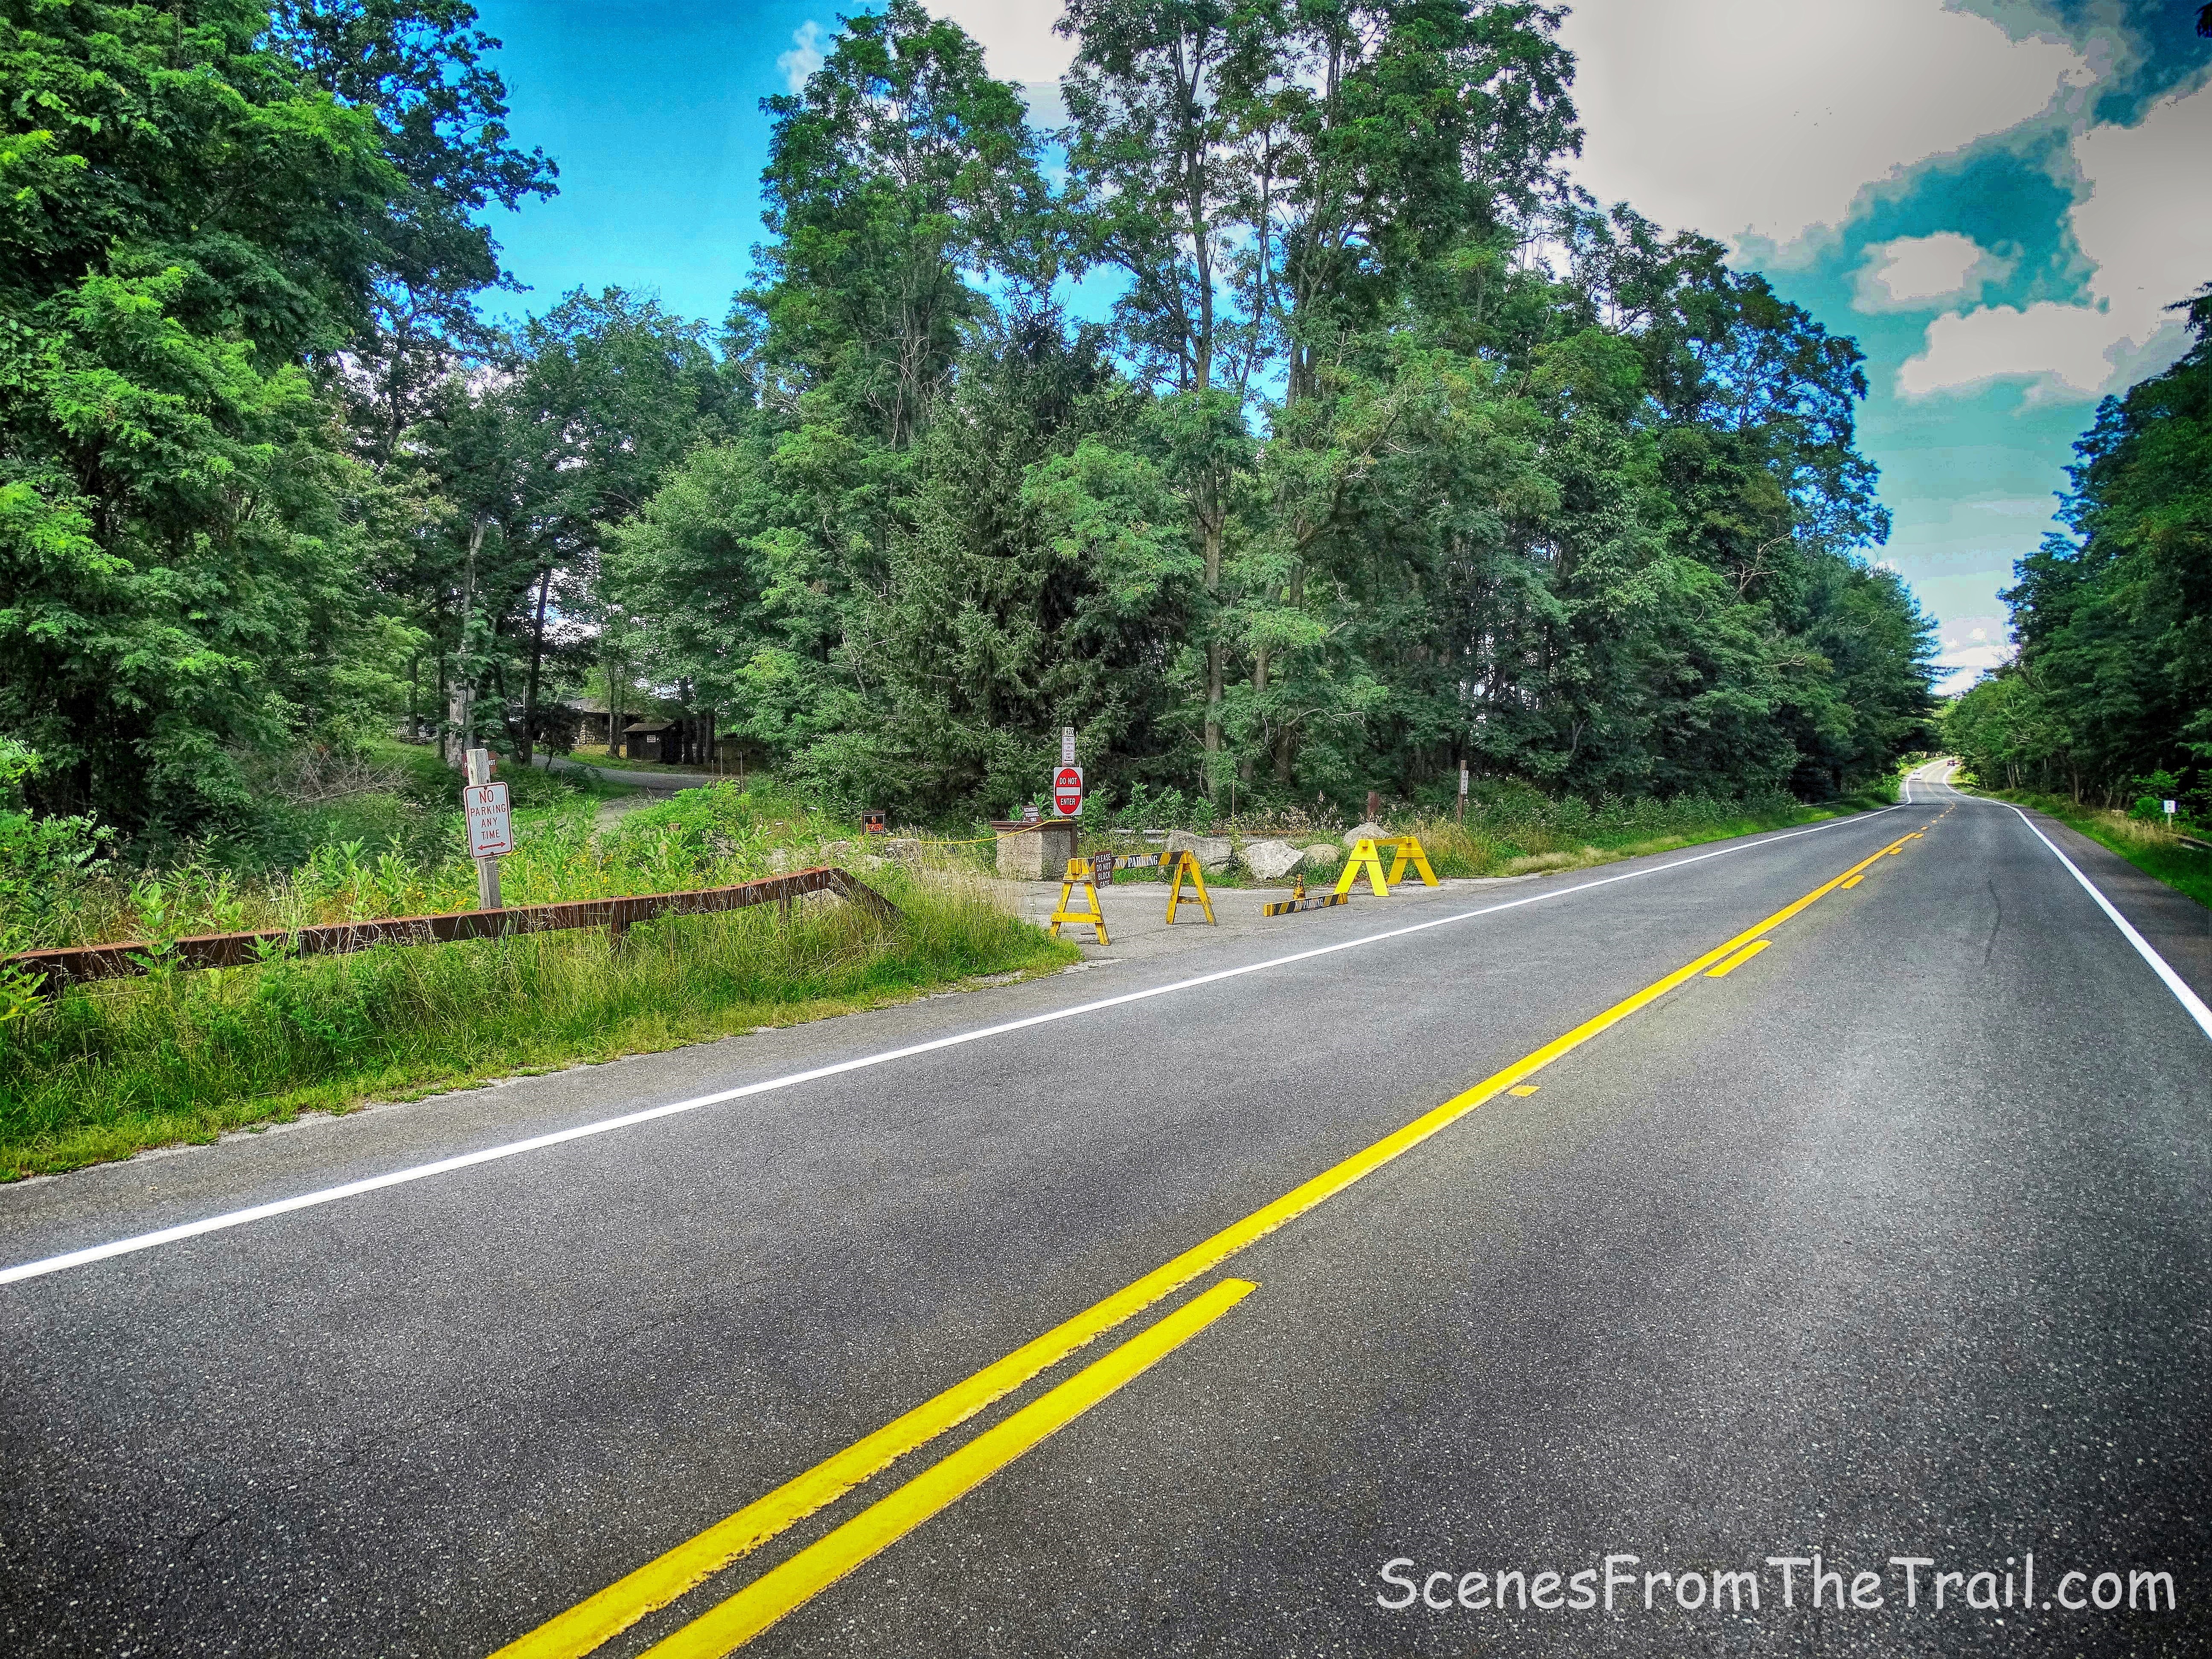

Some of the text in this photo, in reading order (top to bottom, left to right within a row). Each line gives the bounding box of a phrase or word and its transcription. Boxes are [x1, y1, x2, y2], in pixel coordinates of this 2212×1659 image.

[479, 790, 494, 803] NO
[1060, 797, 1075, 806] ENTER
[470, 804, 506, 817] PARKING
[481, 817, 498, 828] ANY
[481, 830, 500, 840] TIME
[1096, 853, 1111, 863] PLEASE
[1115, 855, 1158, 868] NO PARKING
[1103, 862, 1111, 870] NOT
[1098, 871, 1111, 881] BLOCK
[1100, 880, 1110, 888] GATE
[1303, 898, 1323, 909] PARKING
